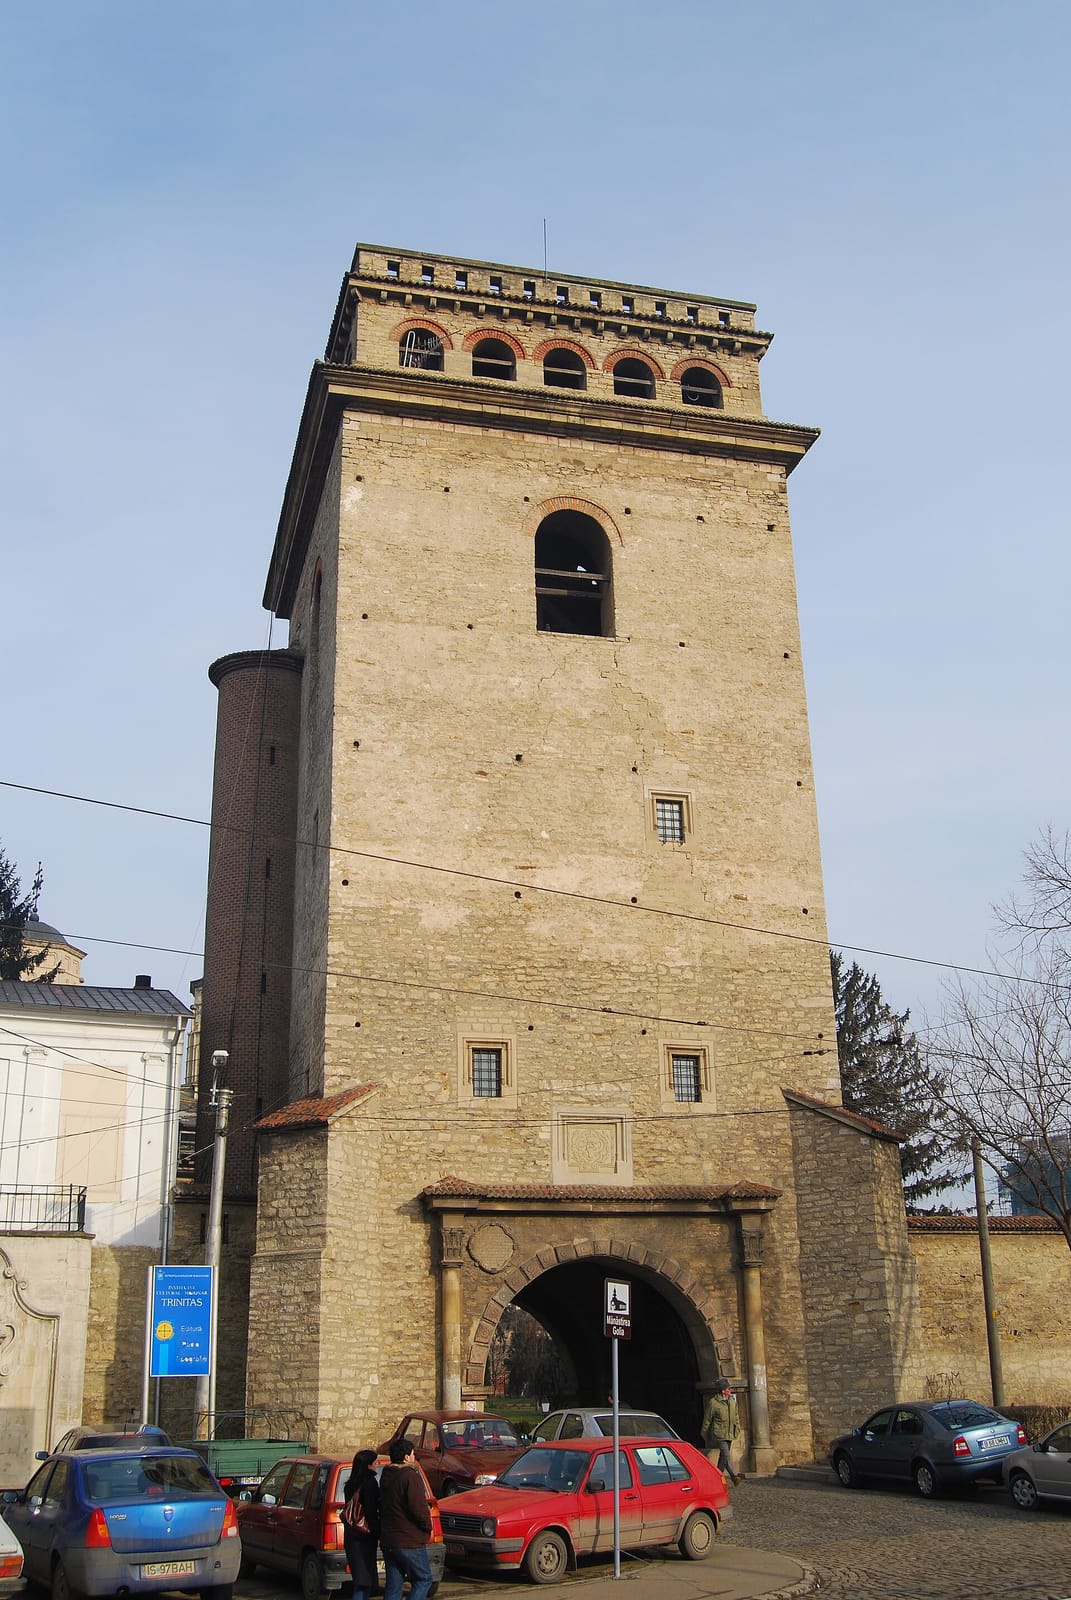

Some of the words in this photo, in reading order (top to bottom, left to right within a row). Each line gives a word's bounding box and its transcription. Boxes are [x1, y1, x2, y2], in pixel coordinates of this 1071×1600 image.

[161, 1298, 203, 1307] TRINITAS
[147, 1564, 156, 1575] IS
[159, 1562, 193, 1575] 97BAH
